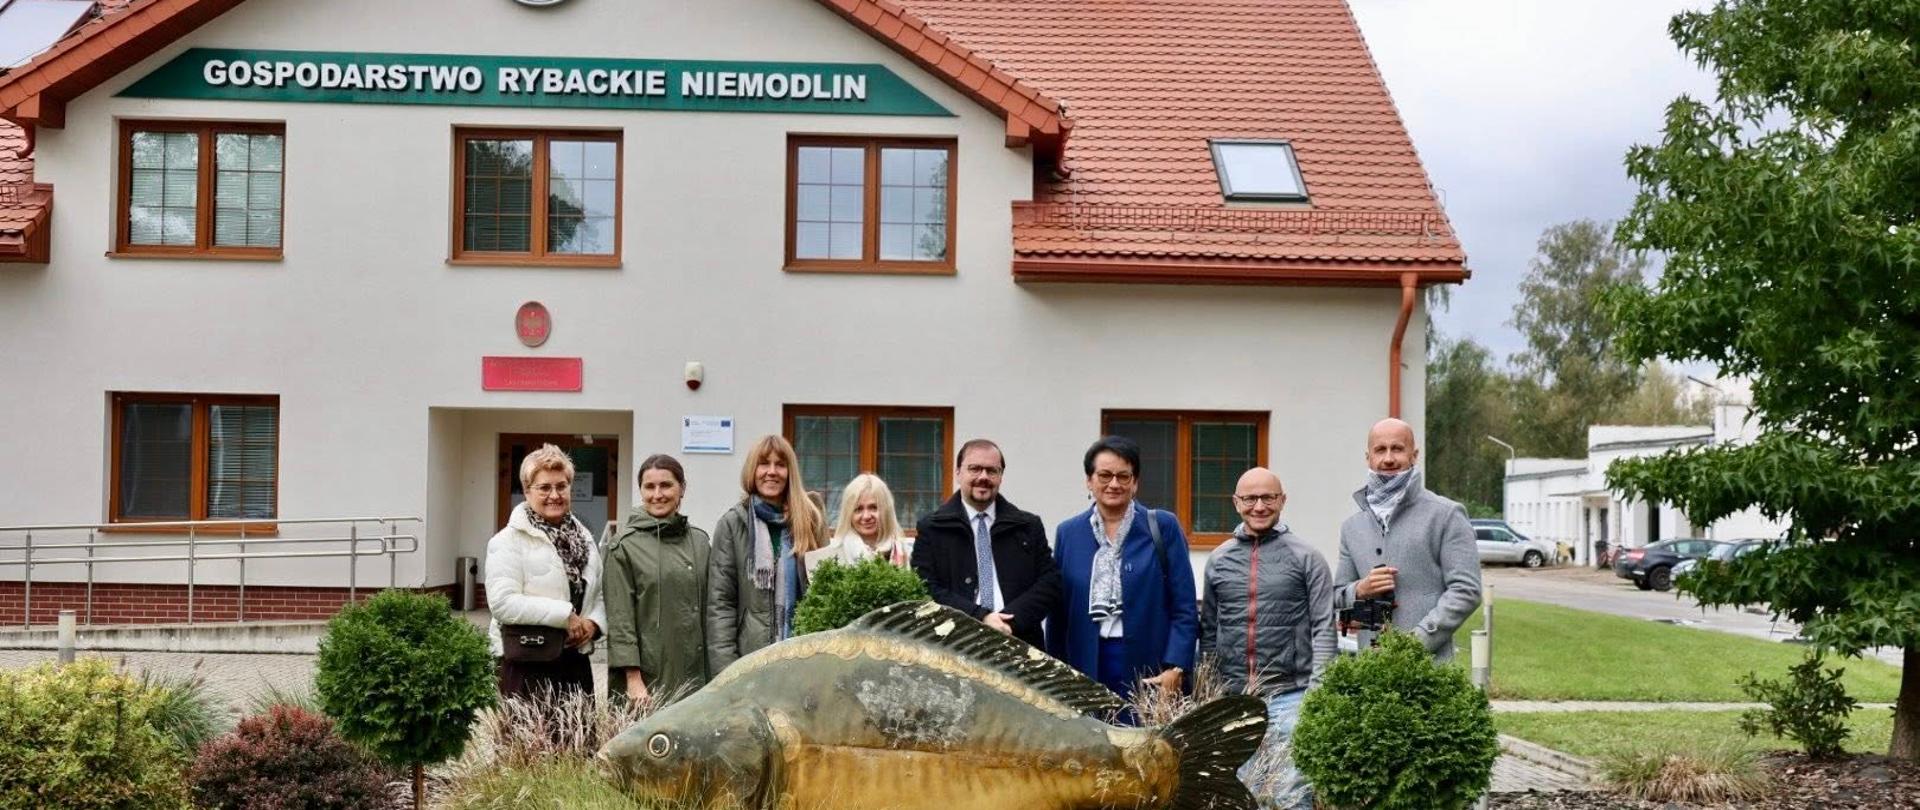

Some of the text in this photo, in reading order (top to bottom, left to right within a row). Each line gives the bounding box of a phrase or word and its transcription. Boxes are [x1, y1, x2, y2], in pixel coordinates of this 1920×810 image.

[203, 59, 867, 100] GOSPODARSTWO RYBACKIE NIEMODLIN
